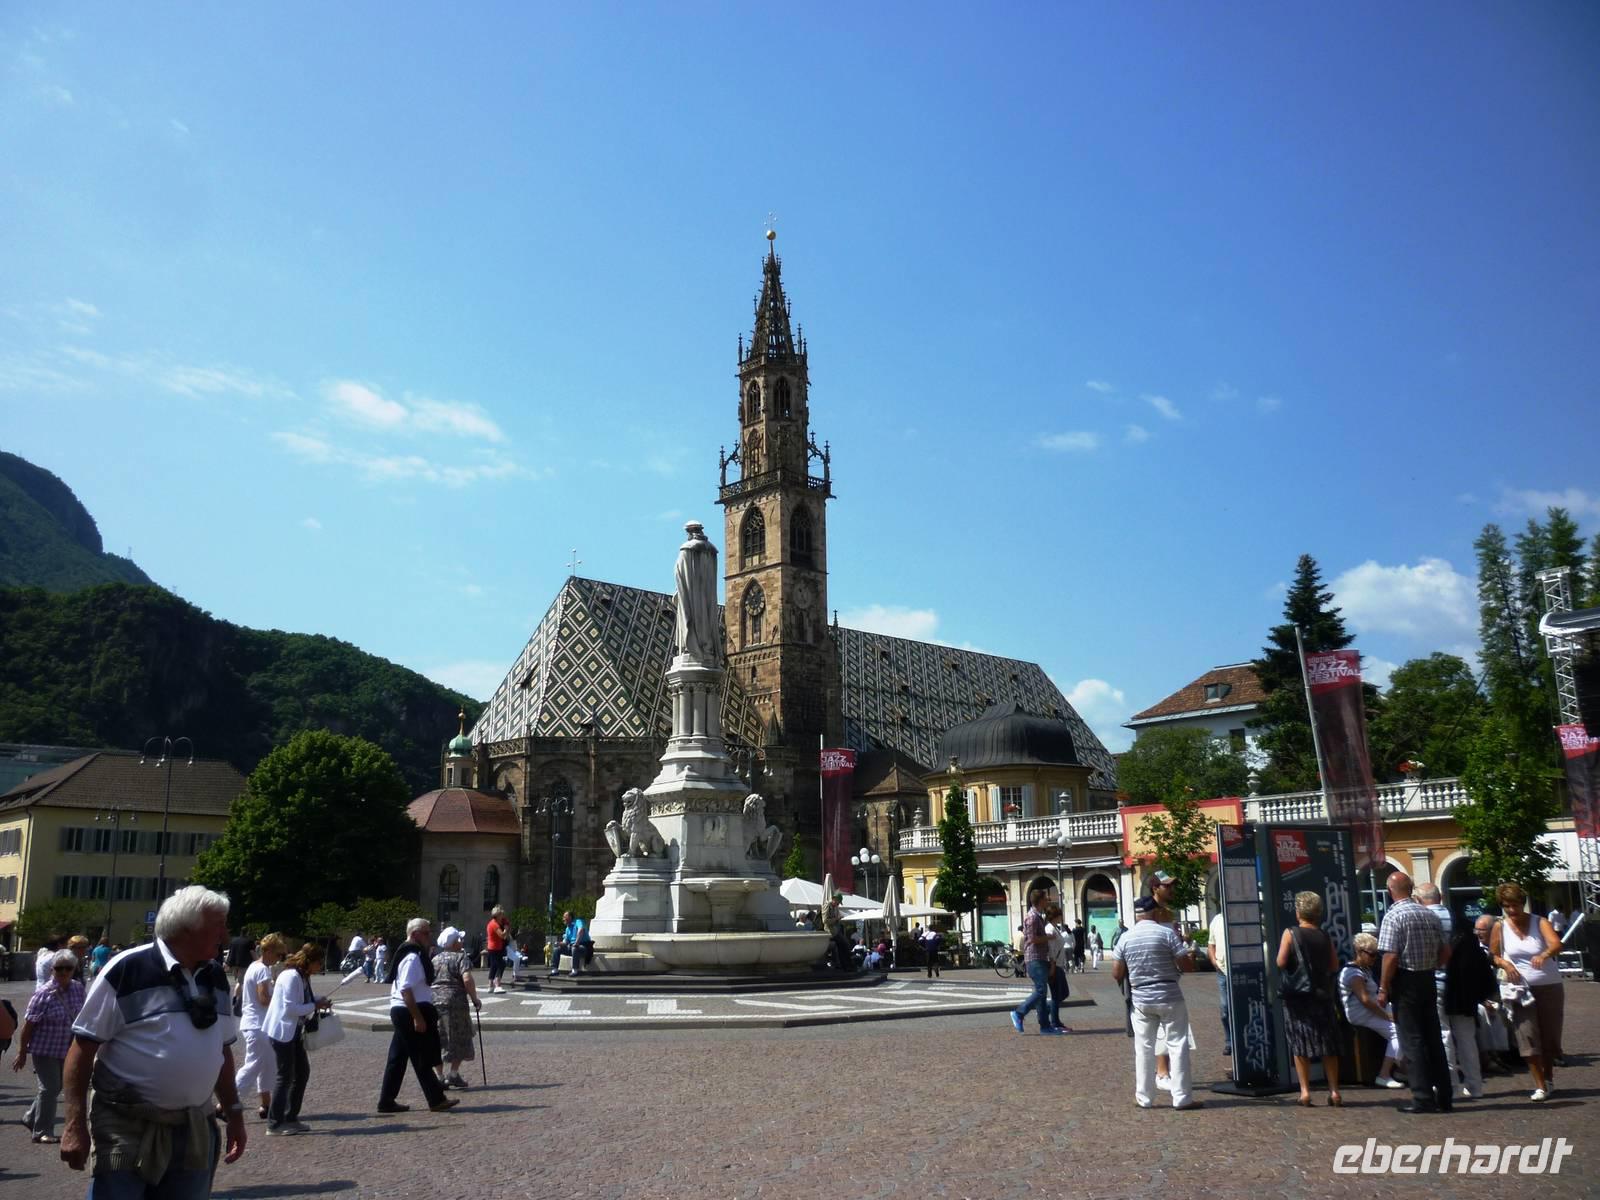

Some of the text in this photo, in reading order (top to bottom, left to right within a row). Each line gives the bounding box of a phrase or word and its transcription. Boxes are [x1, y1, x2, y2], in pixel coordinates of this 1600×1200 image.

[1308, 660, 1348, 671] JAZZ
[1309, 669, 1360, 680] FESTIVAL
[1277, 848, 1309, 858] FESTIVAL
